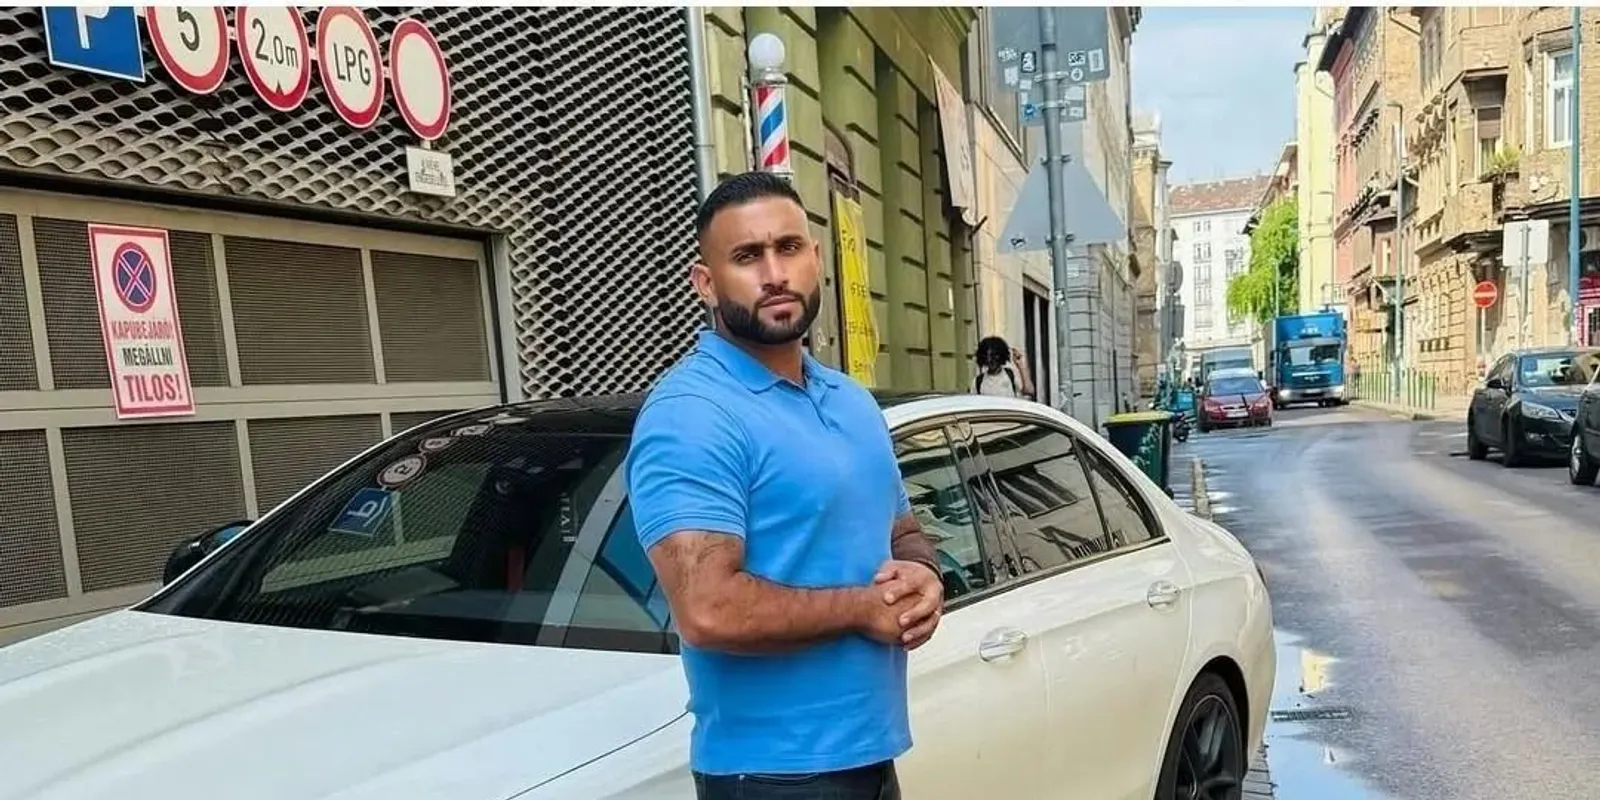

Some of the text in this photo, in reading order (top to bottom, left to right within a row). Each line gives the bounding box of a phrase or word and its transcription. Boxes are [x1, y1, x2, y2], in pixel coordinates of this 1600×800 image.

[177, 6, 200, 51] 5
[334, 43, 371, 85] LPG
[122, 344, 173, 366] MEGÁLLNI
[123, 374, 182, 402] TILOS!
